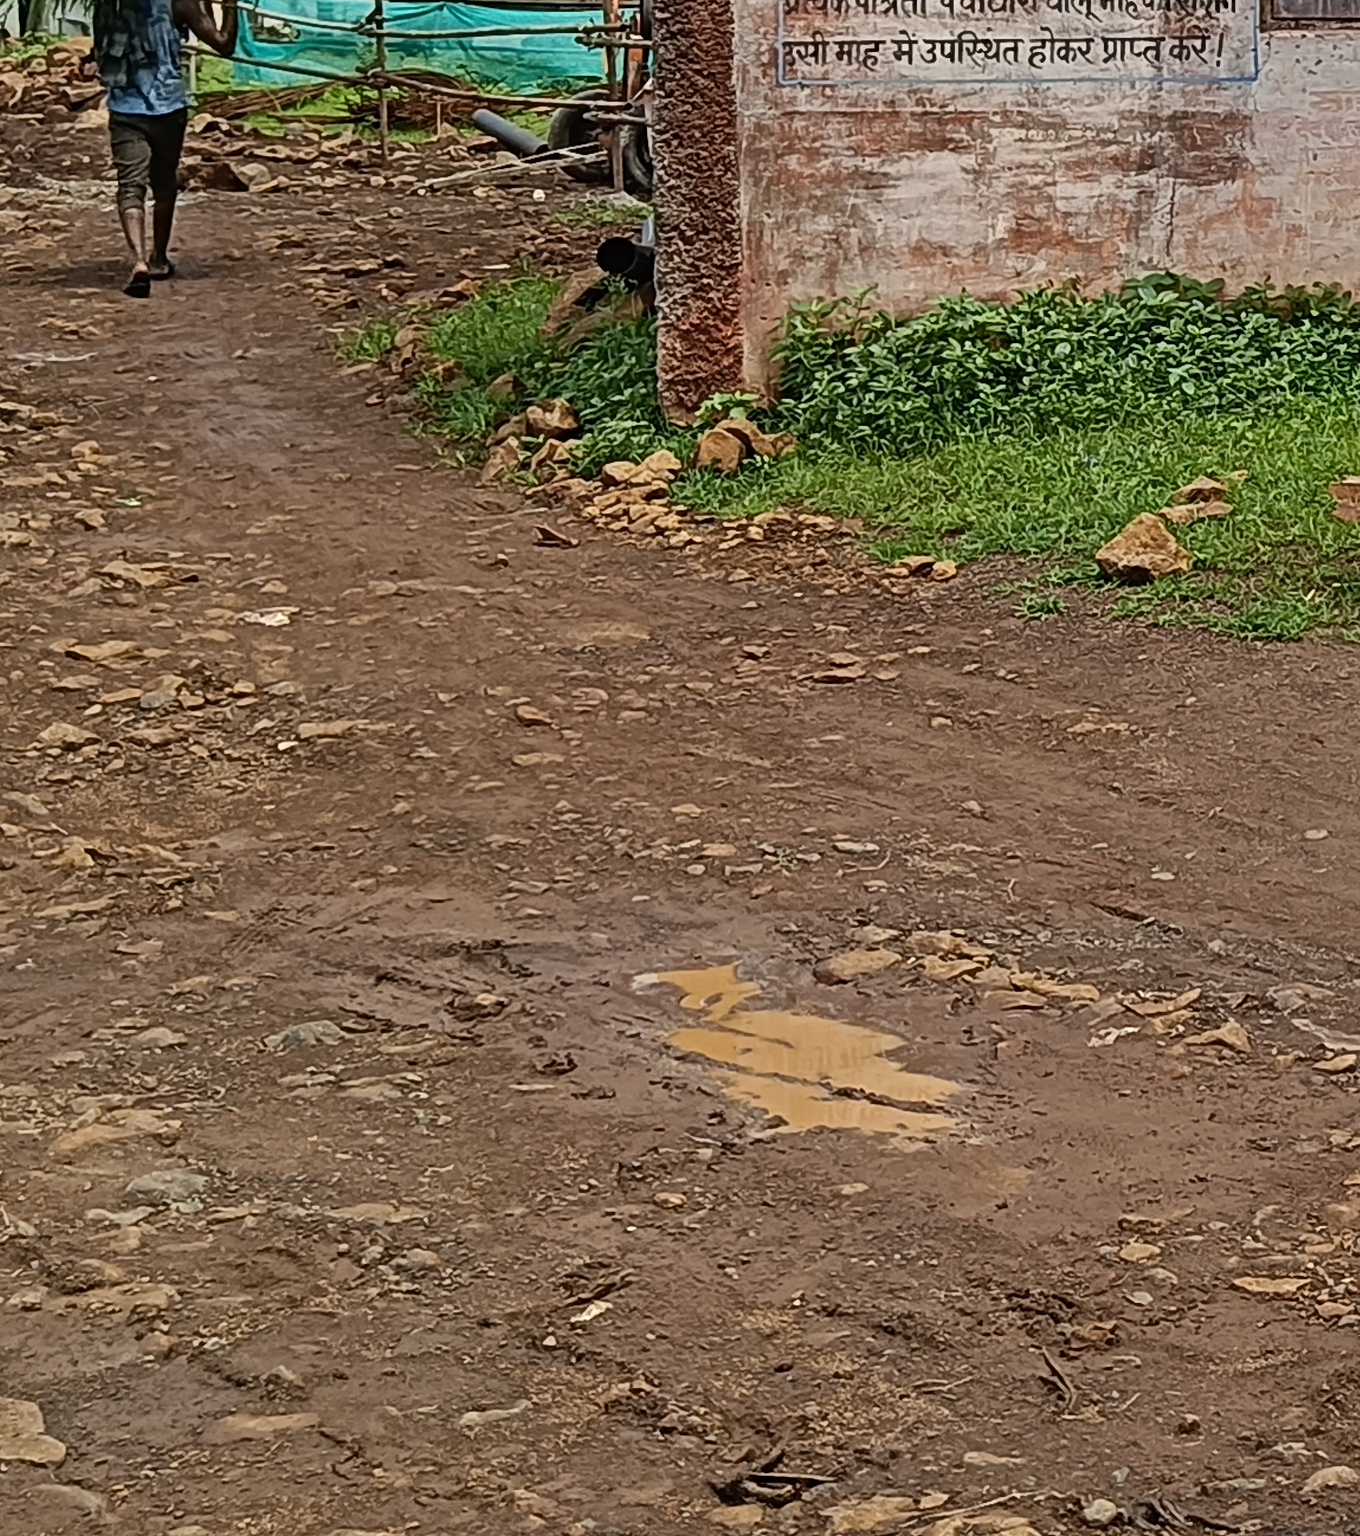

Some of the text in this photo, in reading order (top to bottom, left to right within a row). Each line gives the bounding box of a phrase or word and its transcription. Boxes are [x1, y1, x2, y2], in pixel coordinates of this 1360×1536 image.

[782, 30, 830, 67] उसी
[833, 38, 887, 72] माह
[890, 30, 918, 66] में
[918, 26, 1024, 68] उपस्थित
[1027, 26, 1094, 70] होकर
[1101, 35, 1166, 68] प्राप्त
